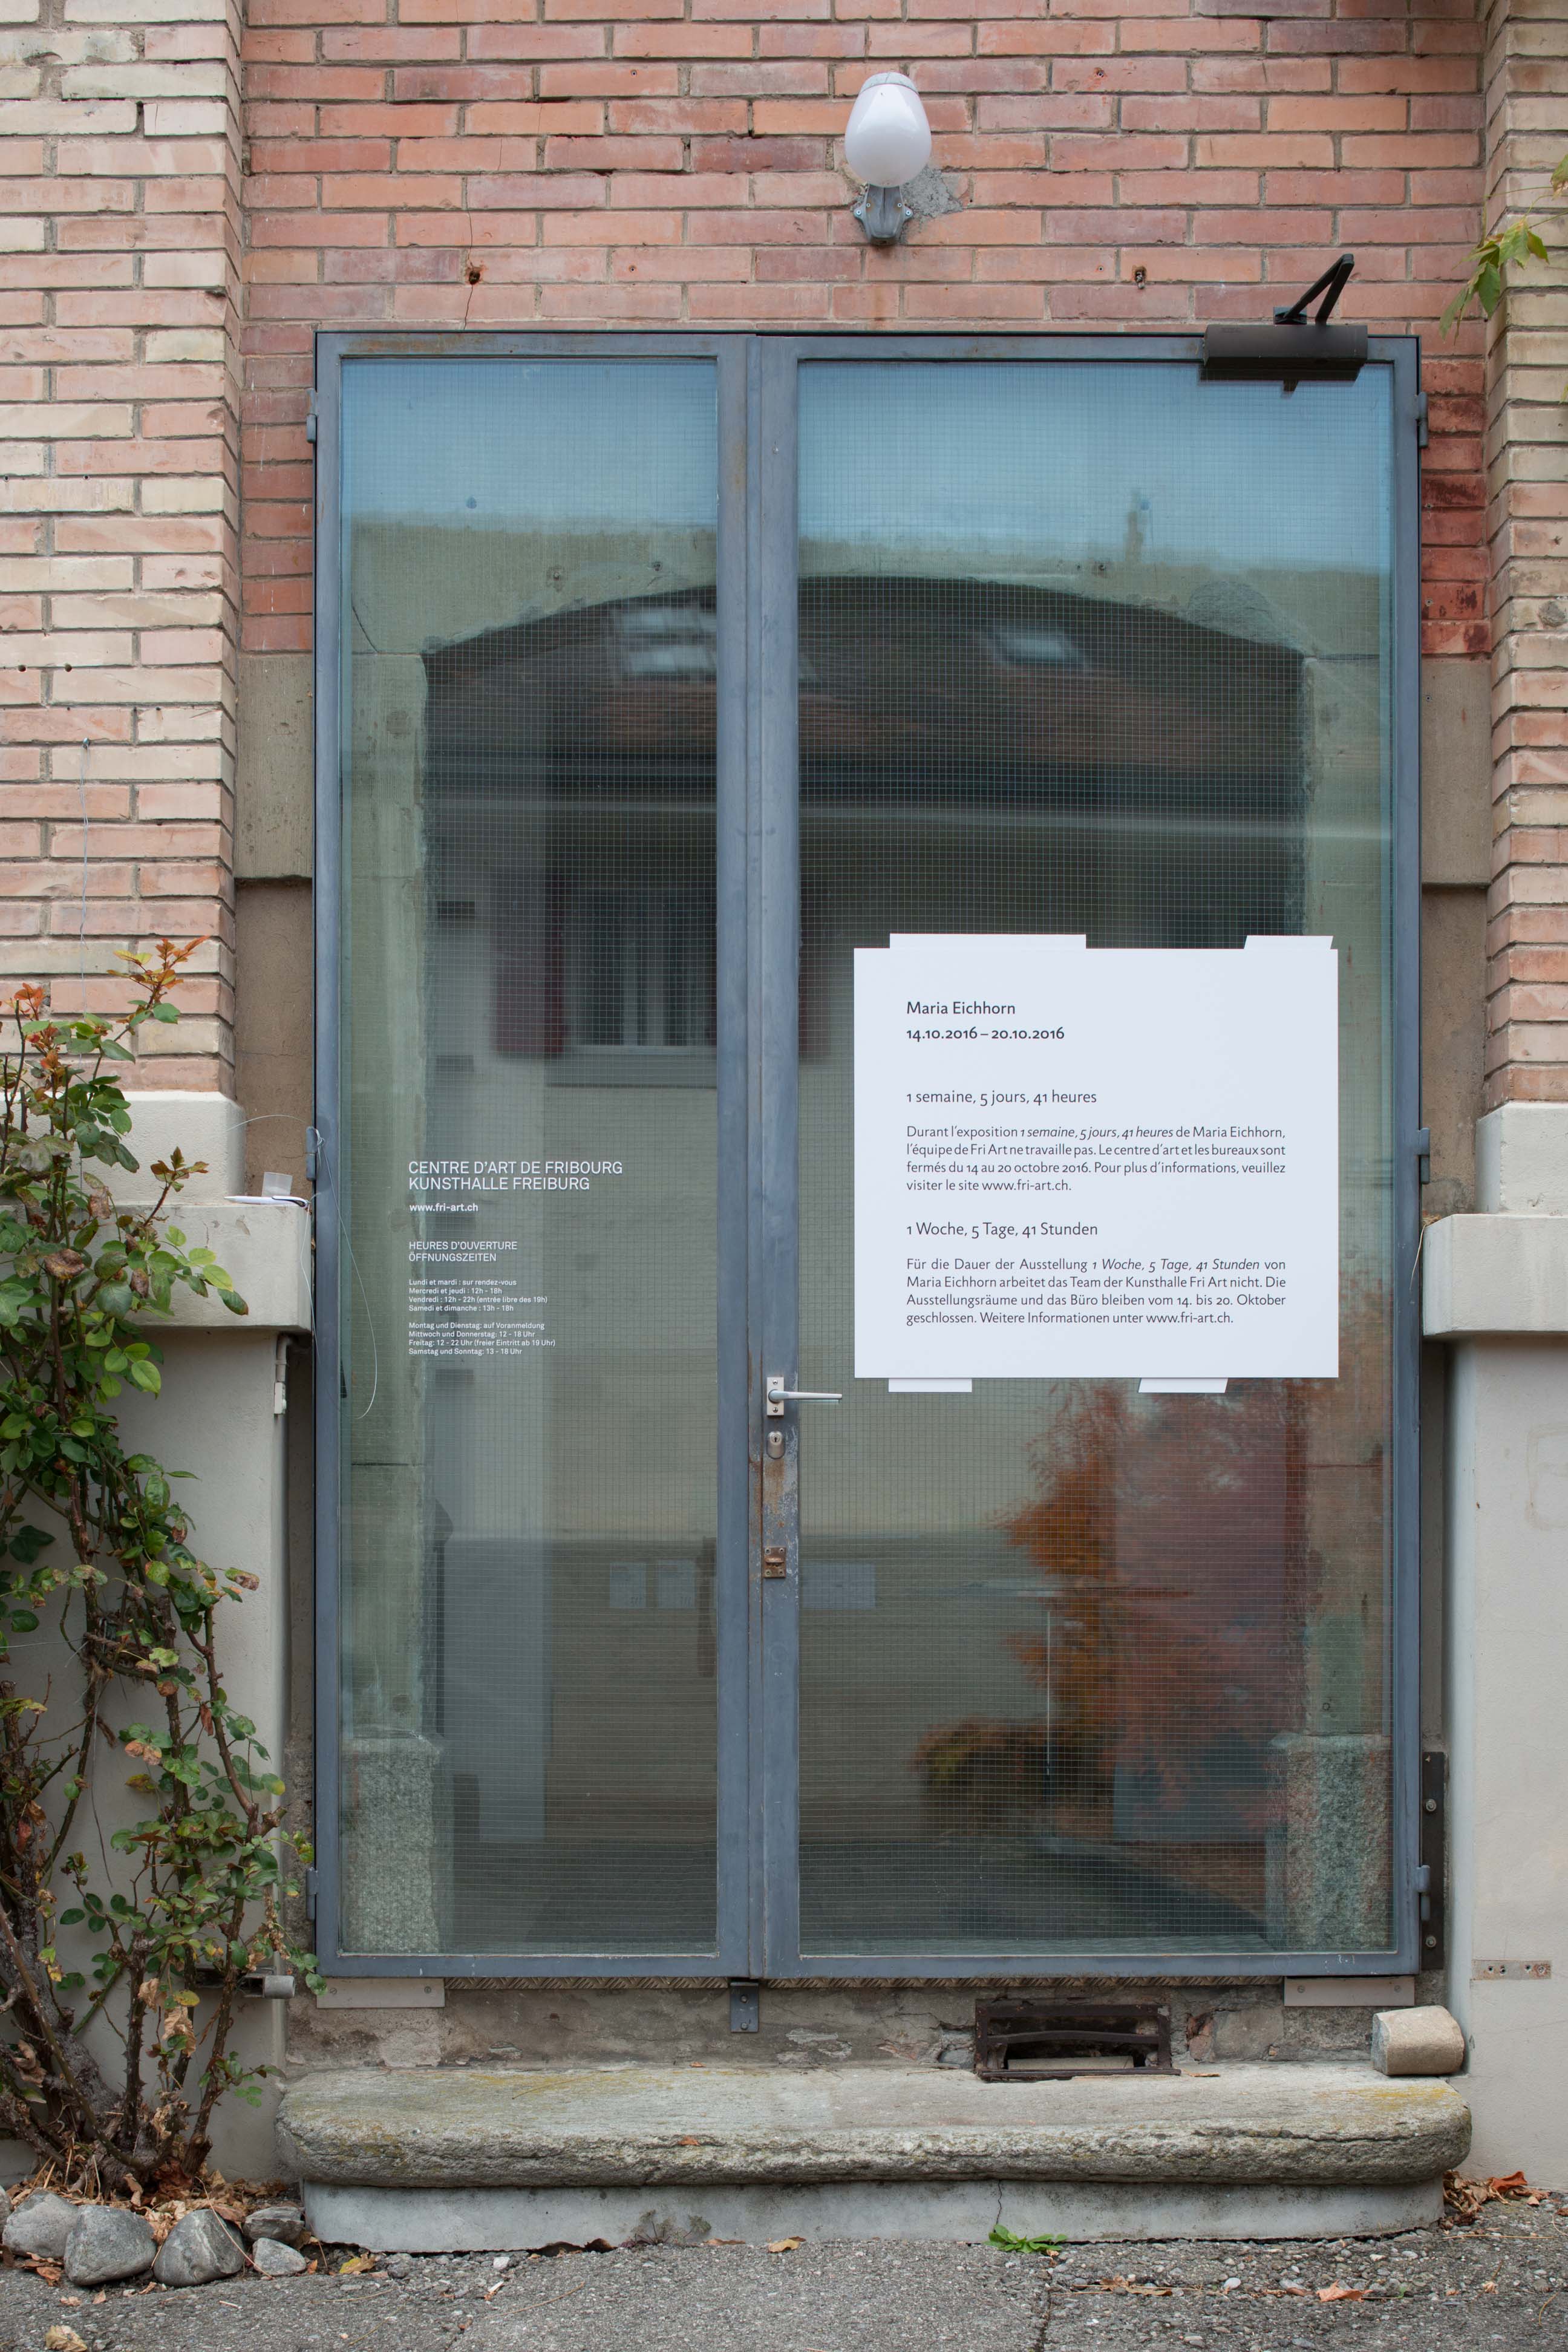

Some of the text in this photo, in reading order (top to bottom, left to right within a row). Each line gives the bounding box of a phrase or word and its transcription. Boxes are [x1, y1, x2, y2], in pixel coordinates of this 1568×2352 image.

[906, 1001, 1016, 1014] Maria Eichhorn
[906, 1026, 1065, 1043] 14.10.2016 20.10.2016
[906, 1089, 1097, 1107] 1 semaine, 5 jours, 41 heures
[907, 1125, 1285, 1140] Durant l'exposition 1 semaine, 5 jours, 41 heures de Maria Eichhorn,
[907, 1143, 953, 1158] l'équipe
[954, 1143, 969, 1155] de
[970, 1143, 985, 1155] Fri
[987, 1143, 1008, 1155] Art
[1025, 1143, 1072, 1155] travaille
[1074, 1147, 1097, 1158] pas.
[1099, 1144, 1112, 1155] Le
[1114, 1146, 1151, 1155] centre
[1152, 1143, 1180, 1155] d'art
[1181, 1146, 1193, 1155] et
[1195, 1143, 1210, 1155] les
[1211, 1143, 1259, 1155] bureaux
[1260, 1146, 1286, 1155] sont
[409, 1161, 622, 1174] CENTRE D'ART DE FRIBOURG
[906, 1161, 1286, 1177] fermés du 14 au 20 octobre 2016. Pour plus d'informations, veuillez
[409, 1177, 590, 1190] KUNSTHALLE FREIBURG
[906, 1178, 1072, 1191] visiter le site www.fri-art.ch.
[409, 1203, 479, 1212] www.fri-art.ch
[906, 1221, 1098, 1240] 1 Woche, 5 Tage, 41 Stunden
[409, 1241, 518, 1250] HEURES D'OUVERTURE
[408, 1251, 497, 1262] ÖFFNUNGSZEITEN
[907, 1258, 1285, 1273] Für die Dauer der Ausstellung 1 Woche, 5 Tage, 41 Stunden von
[907, 1275, 1286, 1288] Maria Eichhorn arbeitet das Team der Kunsthalle Fri Art nicht. Die
[906, 1293, 1287, 1309] Ausstellungsräume und das Büro bleiben vom 14. bis 20. Oktober
[906, 1311, 1233, 1327] geschlossen. Weitere Informationen unter www.fri-art.ch.
